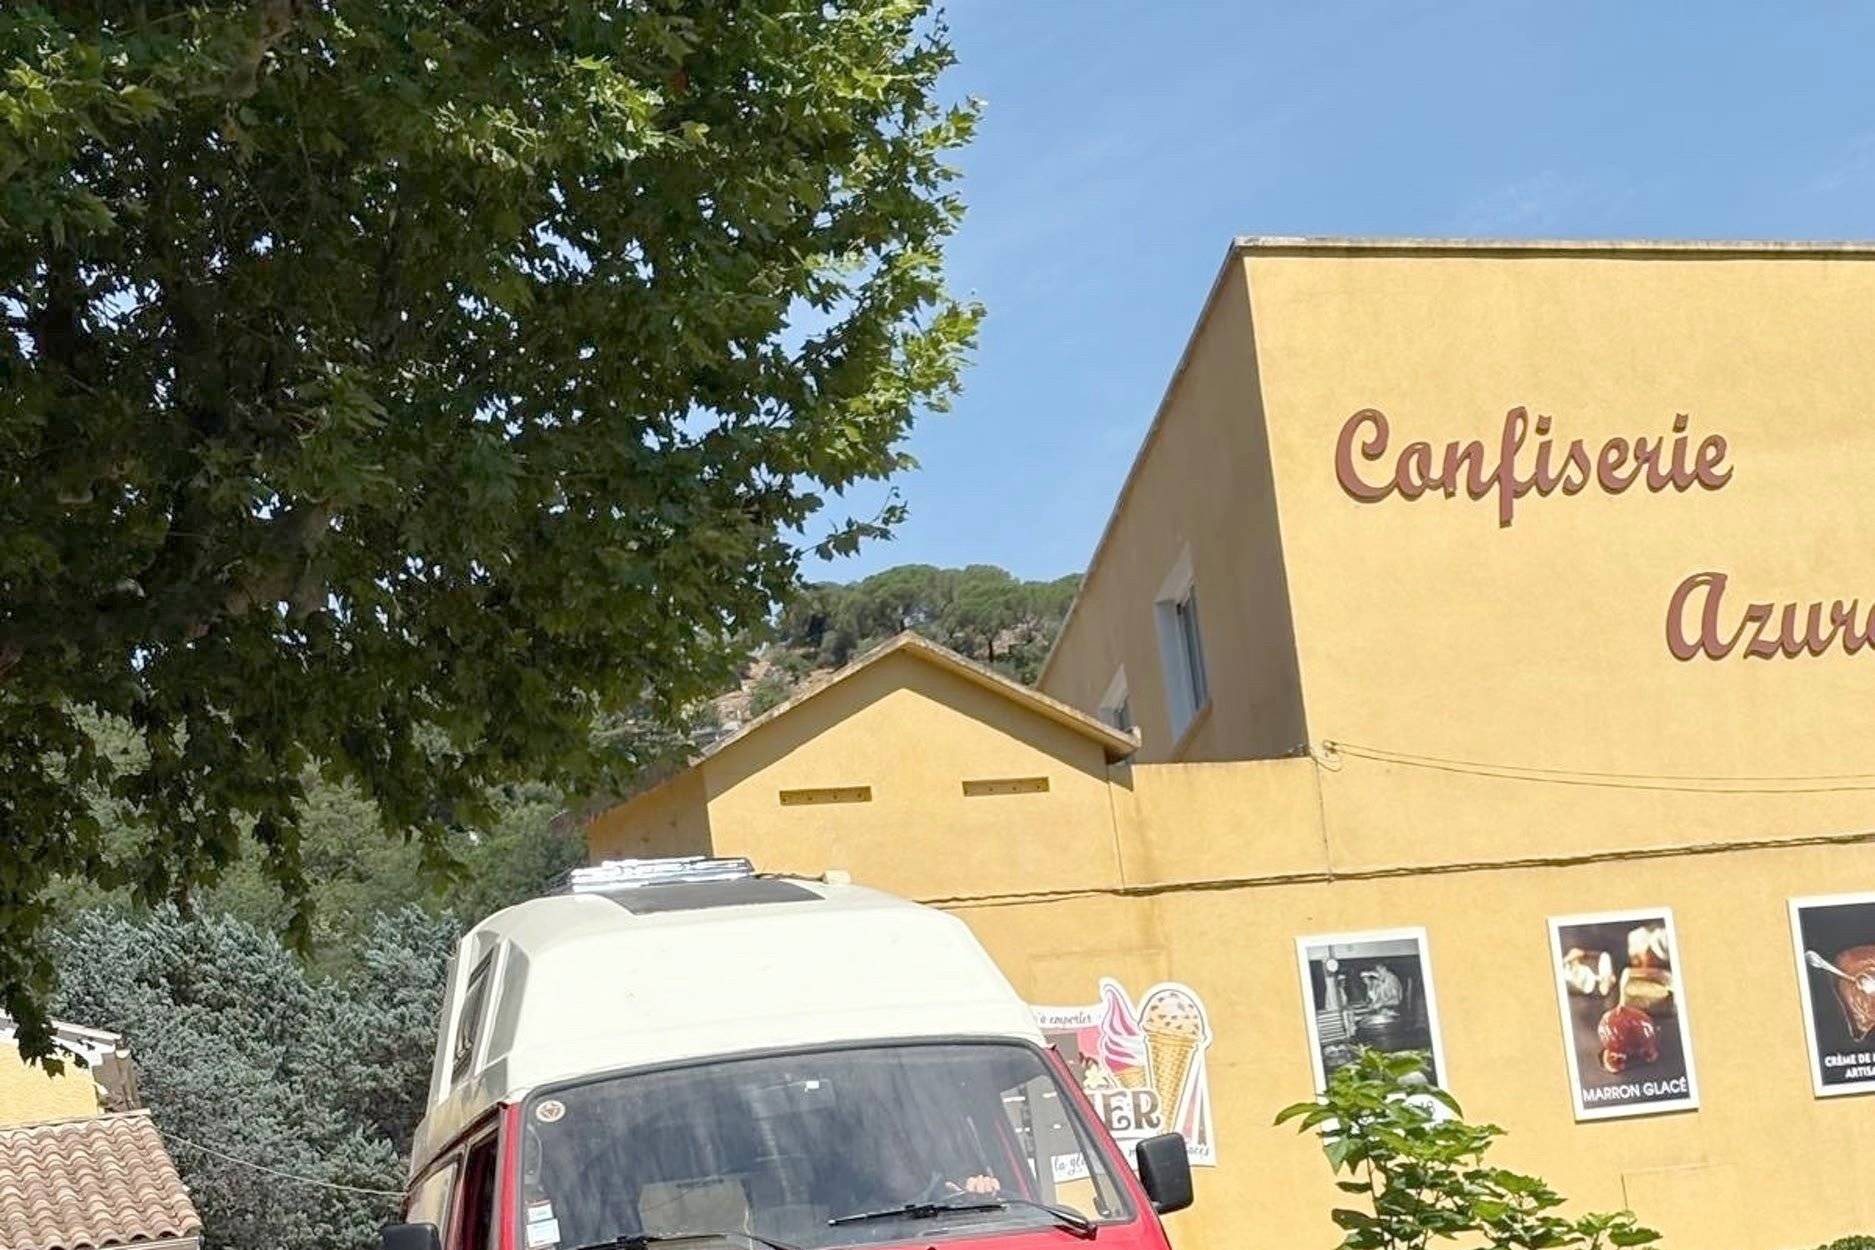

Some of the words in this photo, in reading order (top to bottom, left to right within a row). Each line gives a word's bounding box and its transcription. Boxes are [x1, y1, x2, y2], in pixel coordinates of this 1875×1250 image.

[1334, 405, 1734, 528] Confiserie
[1857, 1052, 1872, 1064] DE
[1583, 1084, 1641, 1101] MARRON
[1643, 1076, 1688, 1096] GLACÉ
